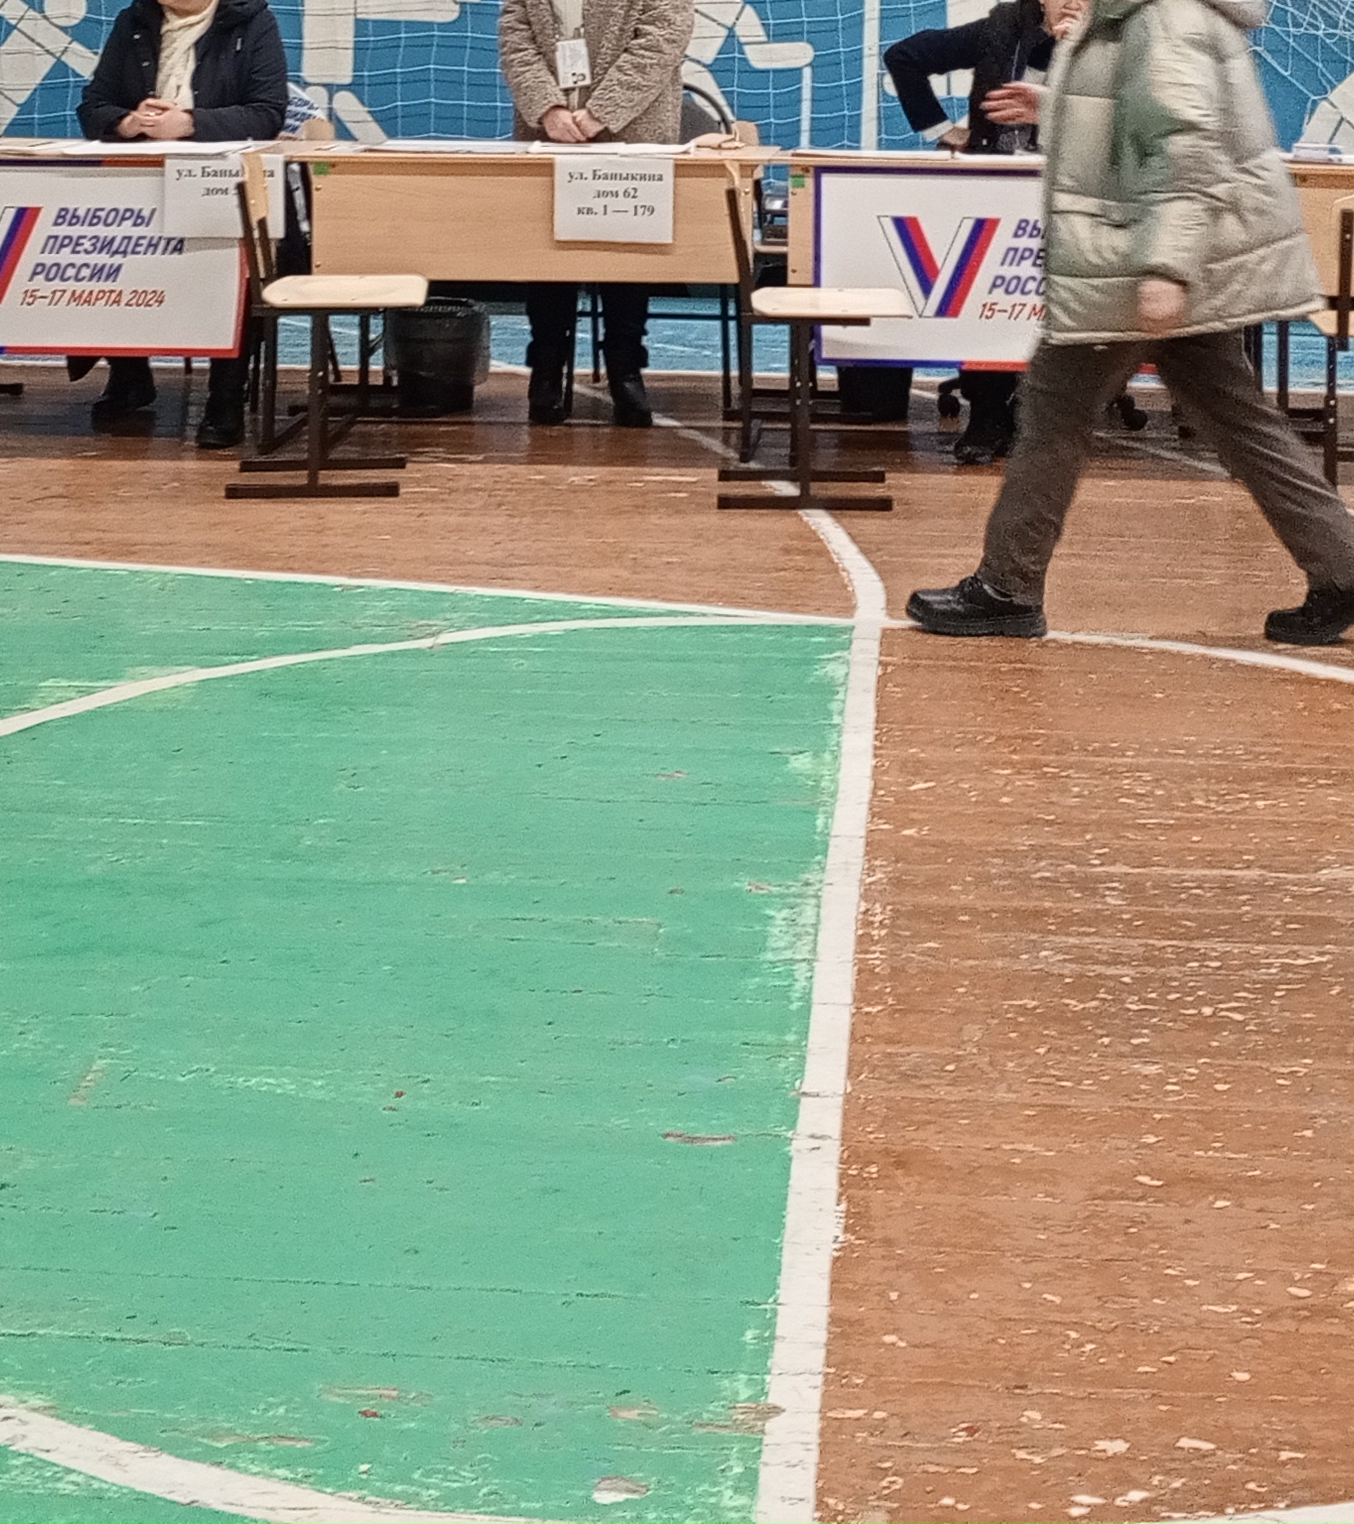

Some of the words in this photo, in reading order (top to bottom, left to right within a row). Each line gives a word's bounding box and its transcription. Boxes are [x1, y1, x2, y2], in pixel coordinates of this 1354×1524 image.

[176, 168, 197, 181] ул.
[567, 170, 588, 183] ул.
[592, 168, 664, 182] Баныкина
[201, 187, 230, 197] дом
[593, 189, 620, 199] дом
[622, 186, 639, 199] 62
[52, 207, 158, 228] ВЫБОРЫ
[577, 206, 598, 216] кв.
[602, 204, 608, 216] 1
[632, 204, 656, 217] 179
[39, 234, 187, 259] ПРЕЗИДЕНТА
[27, 262, 125, 283] РОССИИ
[988, 275, 1046, 297] РОСС
[68, 289, 124, 308] МАРТА
[125, 290, 167, 309] 2024
